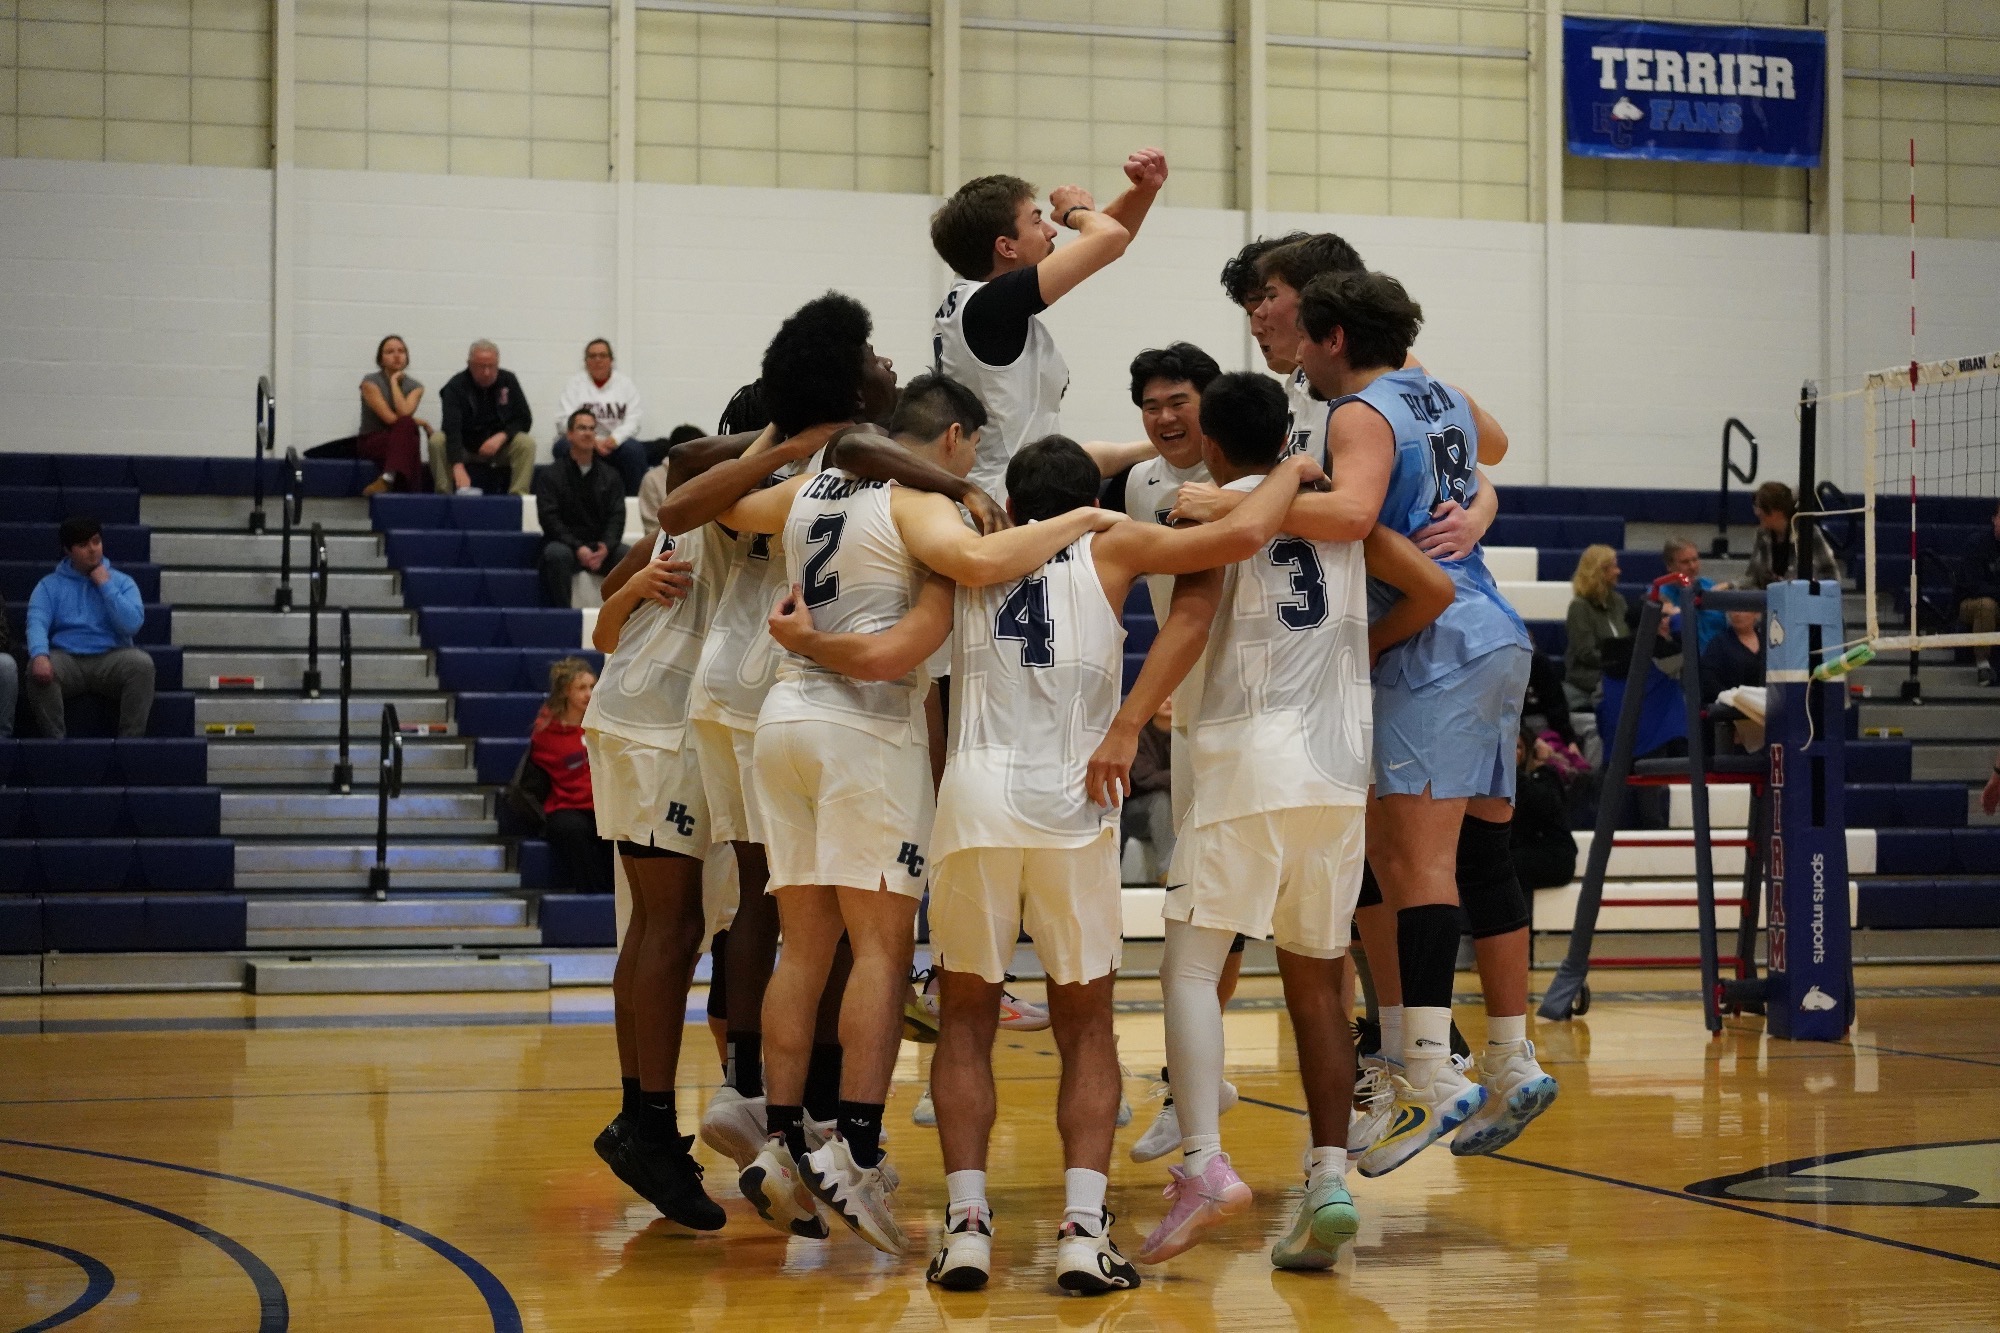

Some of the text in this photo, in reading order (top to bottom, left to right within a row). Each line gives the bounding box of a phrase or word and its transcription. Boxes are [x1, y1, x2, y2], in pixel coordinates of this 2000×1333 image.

[1591, 46, 1796, 99] TERRIER
[1650, 99, 1743, 134] FANS
[802, 510, 847, 610] 2
[1268, 538, 1329, 631] 3
[994, 576, 1054, 667] 4
[665, 801, 695, 836] HC
[897, 841, 924, 877] HC
[1769, 743, 1786, 973] HIRAM
[1811, 853, 1825, 964] sports imports
